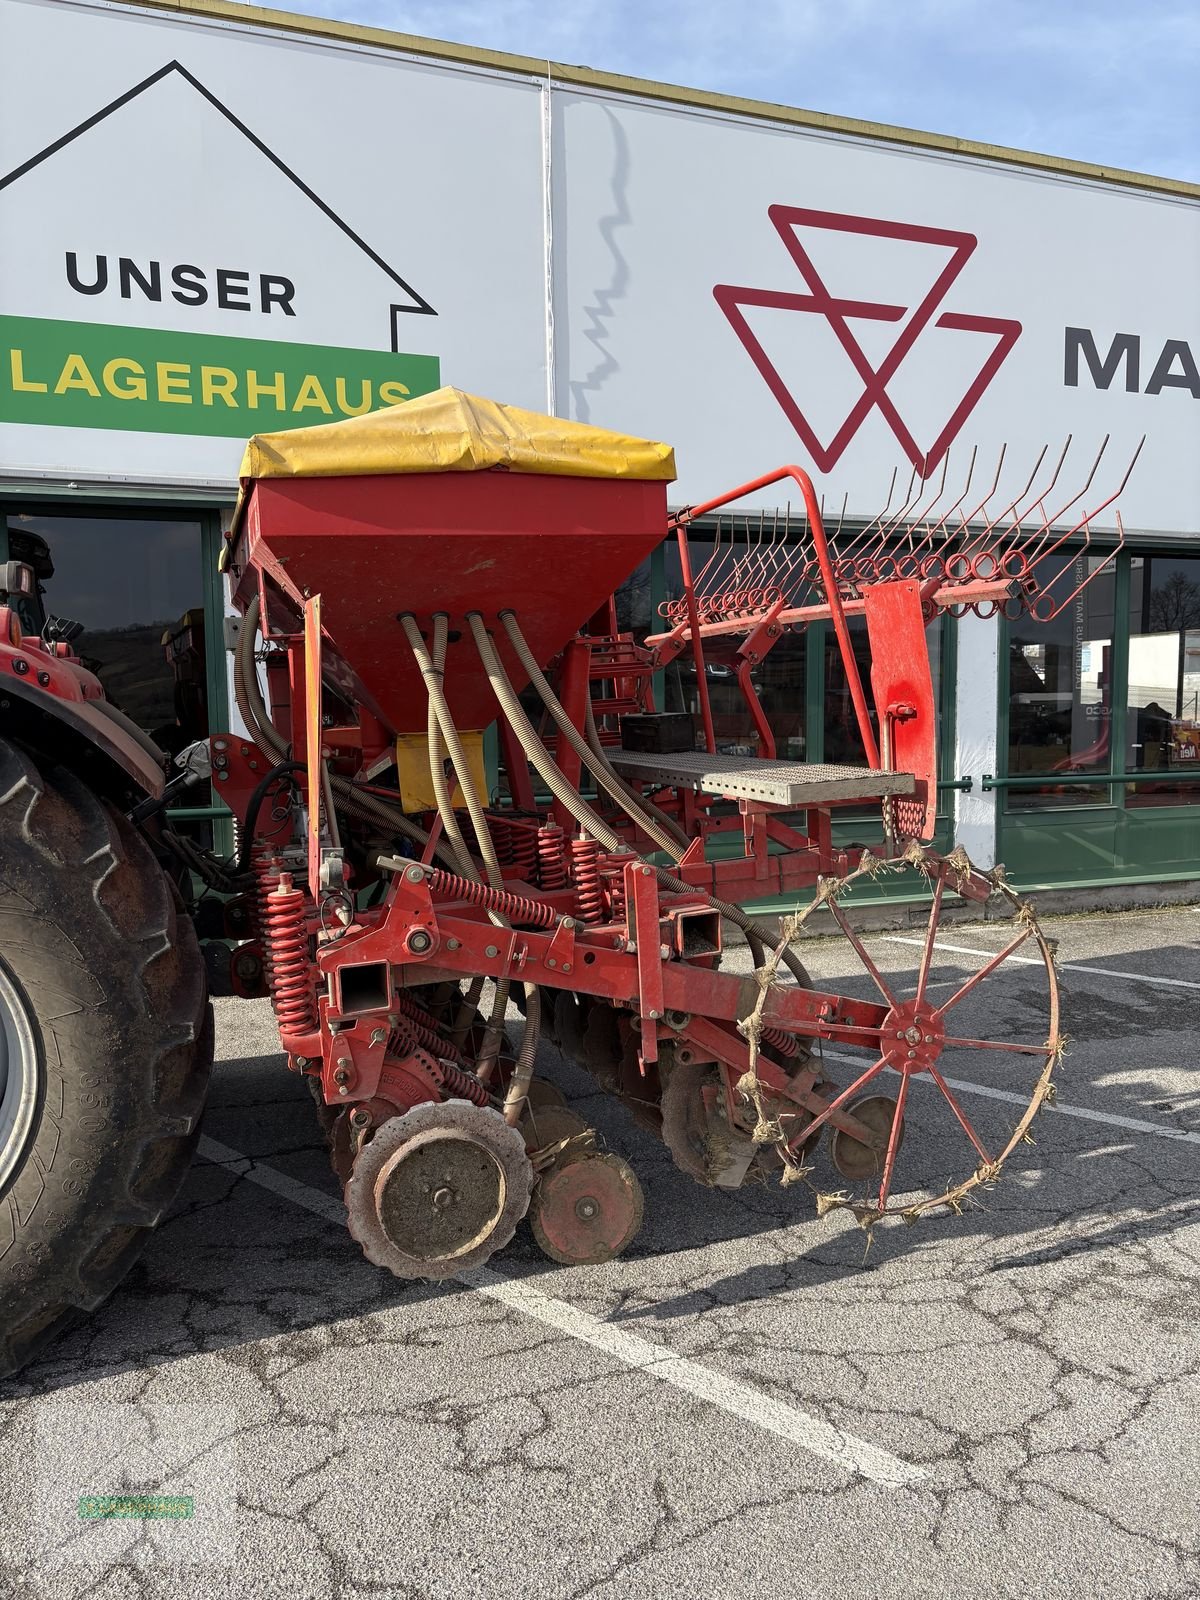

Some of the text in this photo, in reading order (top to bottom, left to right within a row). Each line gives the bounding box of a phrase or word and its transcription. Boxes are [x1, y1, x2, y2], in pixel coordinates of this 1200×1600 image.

[65, 251, 297, 316] UNSER
[10, 349, 411, 416] LAGERHAUS
[1064, 326, 1200, 399] MA
